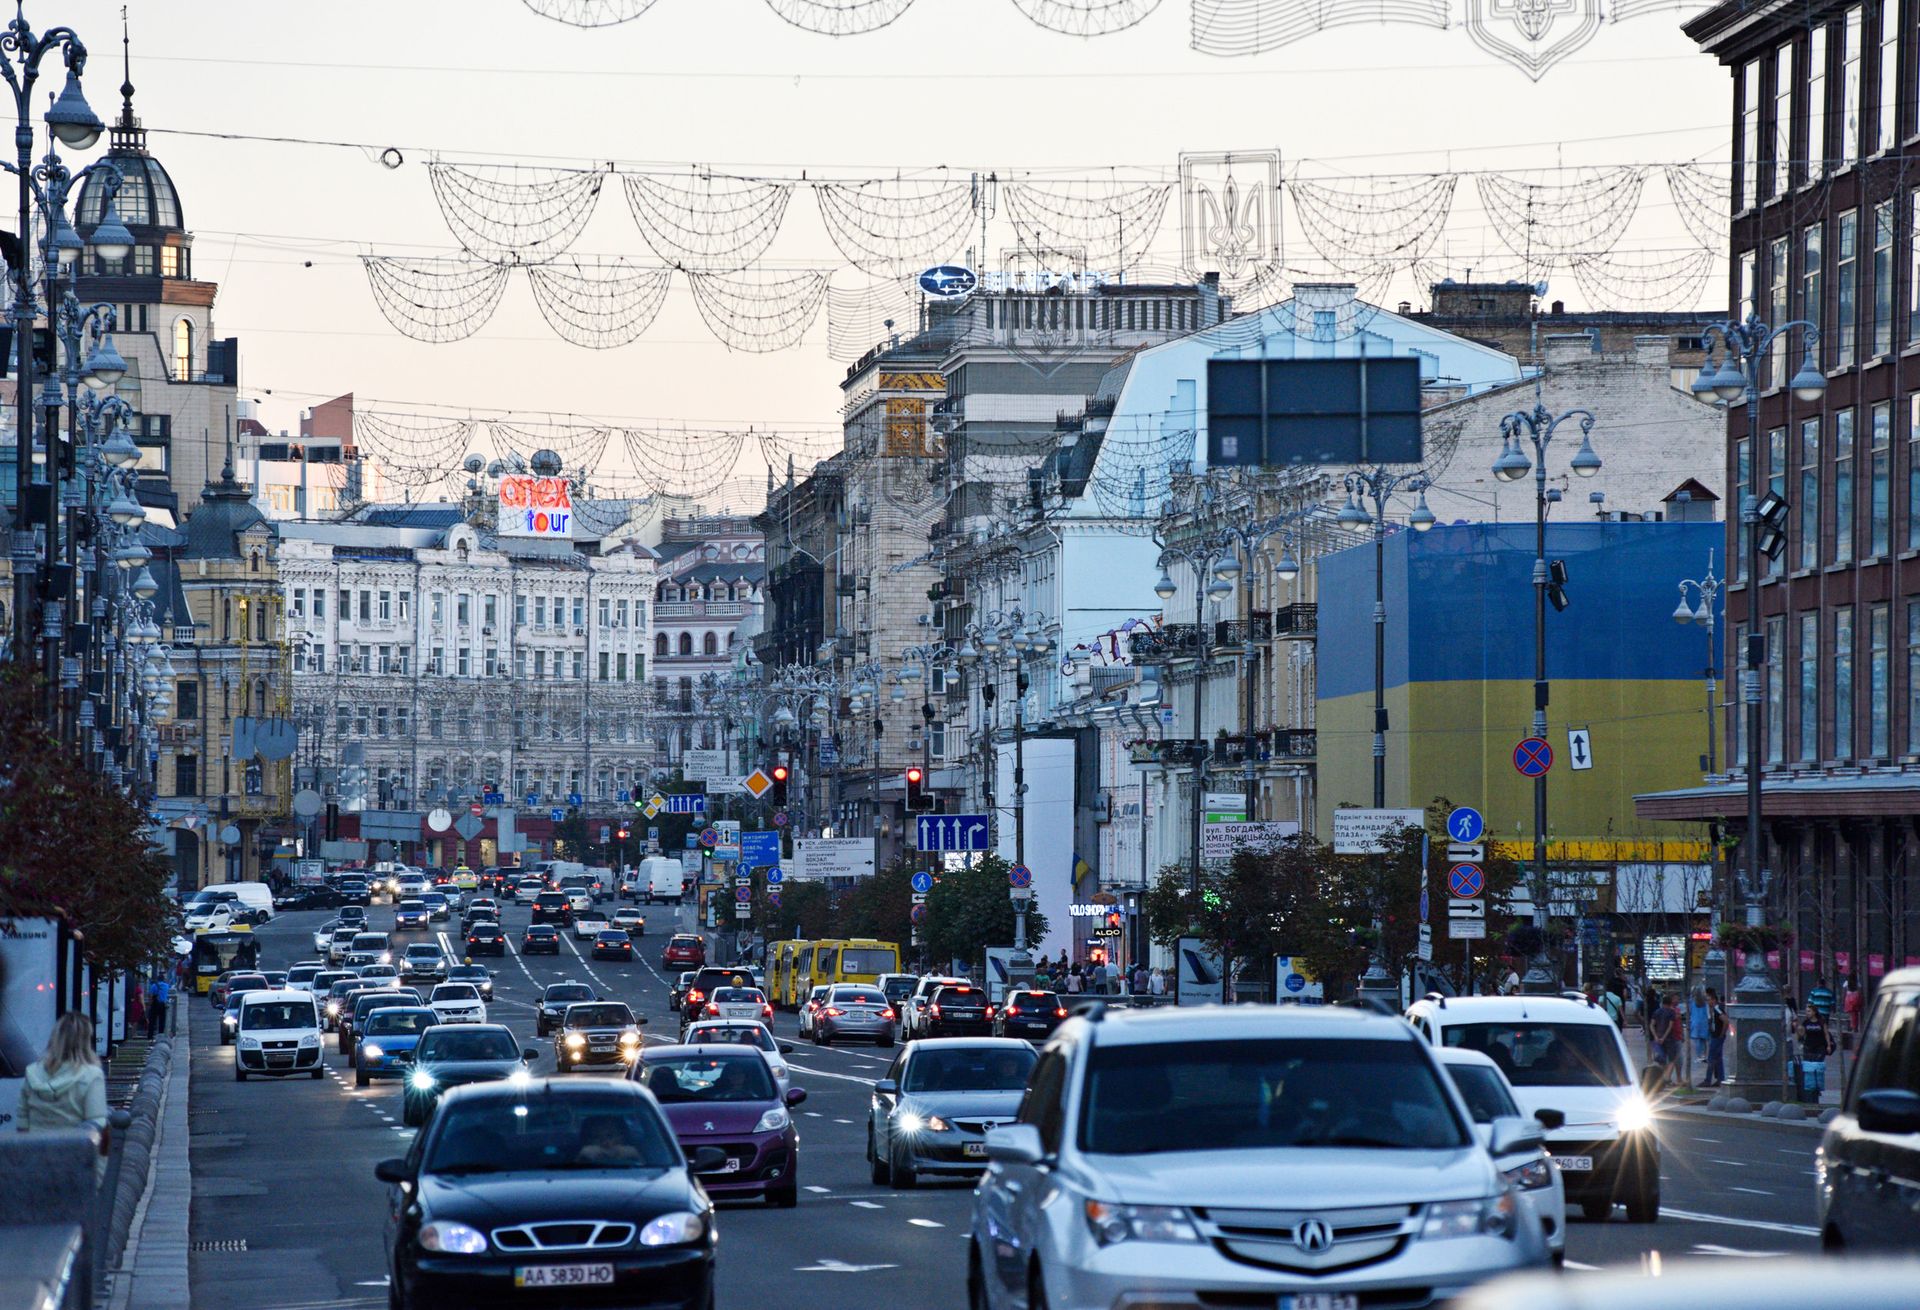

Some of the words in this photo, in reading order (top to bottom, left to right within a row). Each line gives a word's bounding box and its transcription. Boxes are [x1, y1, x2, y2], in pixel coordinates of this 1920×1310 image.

[500, 477, 571, 508] anex
[526, 510, 569, 533] tour
[1205, 827, 1222, 835] вул.
[1069, 904, 1085, 916] YOLO
[1576, 1158, 1591, 1169] CB
[525, 1268, 545, 1284] AA
